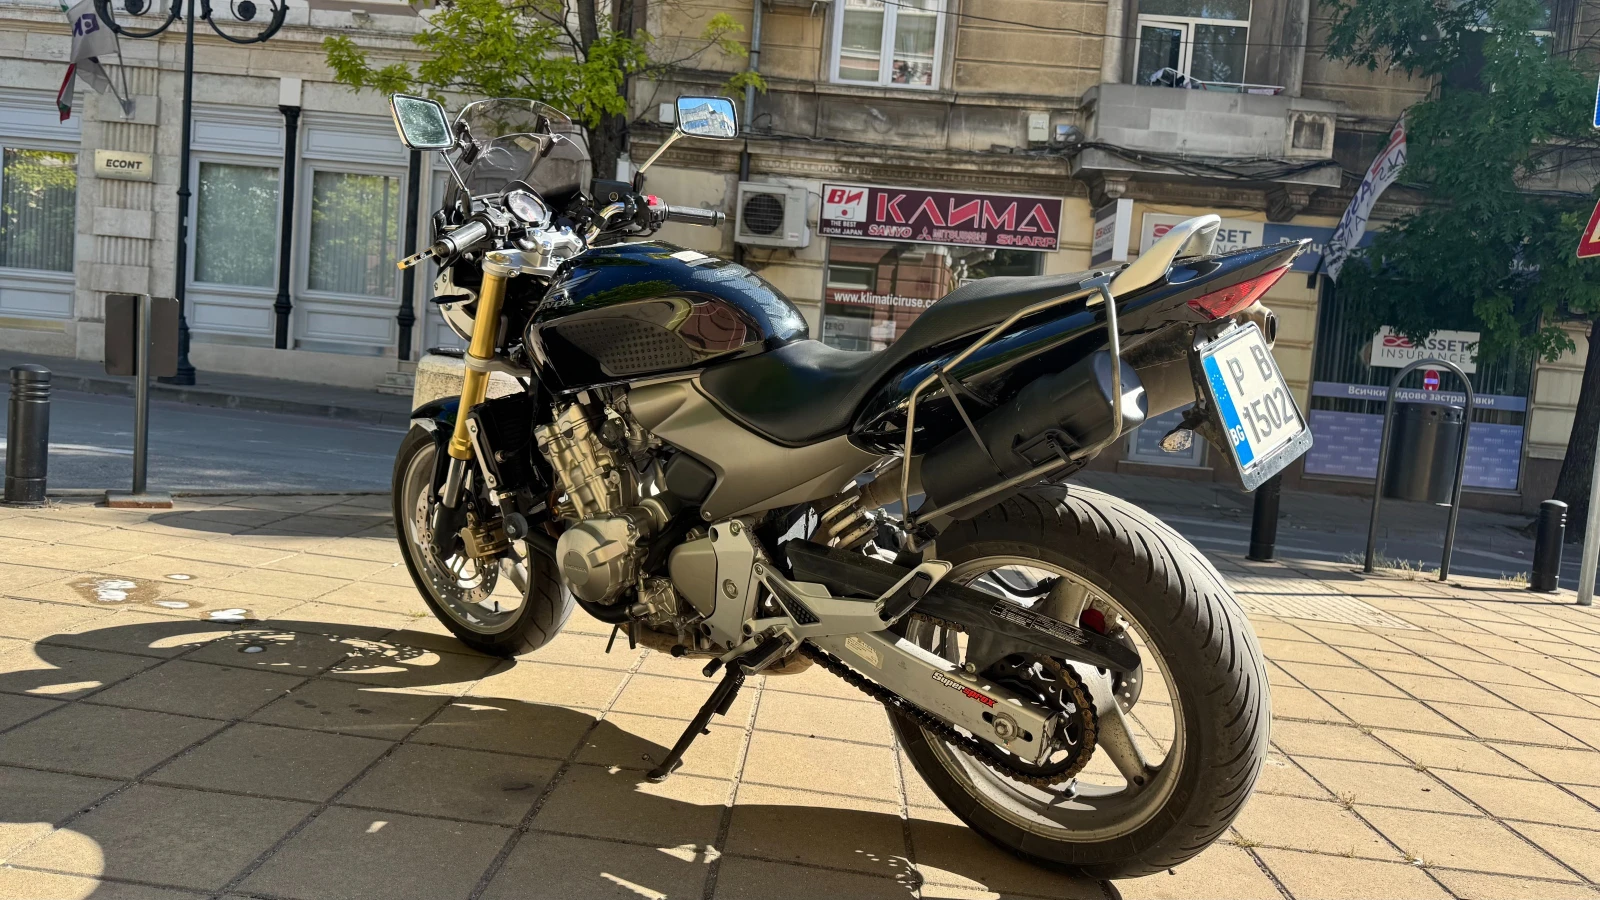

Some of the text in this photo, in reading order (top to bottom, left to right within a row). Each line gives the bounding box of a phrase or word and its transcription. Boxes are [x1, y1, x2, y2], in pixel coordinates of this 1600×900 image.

[106, 159, 143, 170] ECONT
[876, 192, 1056, 234] КЛИМА
[842, 228, 863, 236] JAPAN
[868, 224, 912, 238] SANYO
[1216, 228, 1252, 244] SET
[825, 321, 845, 331] ZERO
[1381, 348, 1466, 363] INSURANCE
[1348, 385, 1386, 397] Всички
[1394, 390, 1427, 401] идове
[1242, 386, 1294, 445] 1502
[1229, 424, 1246, 447] BG
[932, 671, 998, 708] Supersprox
